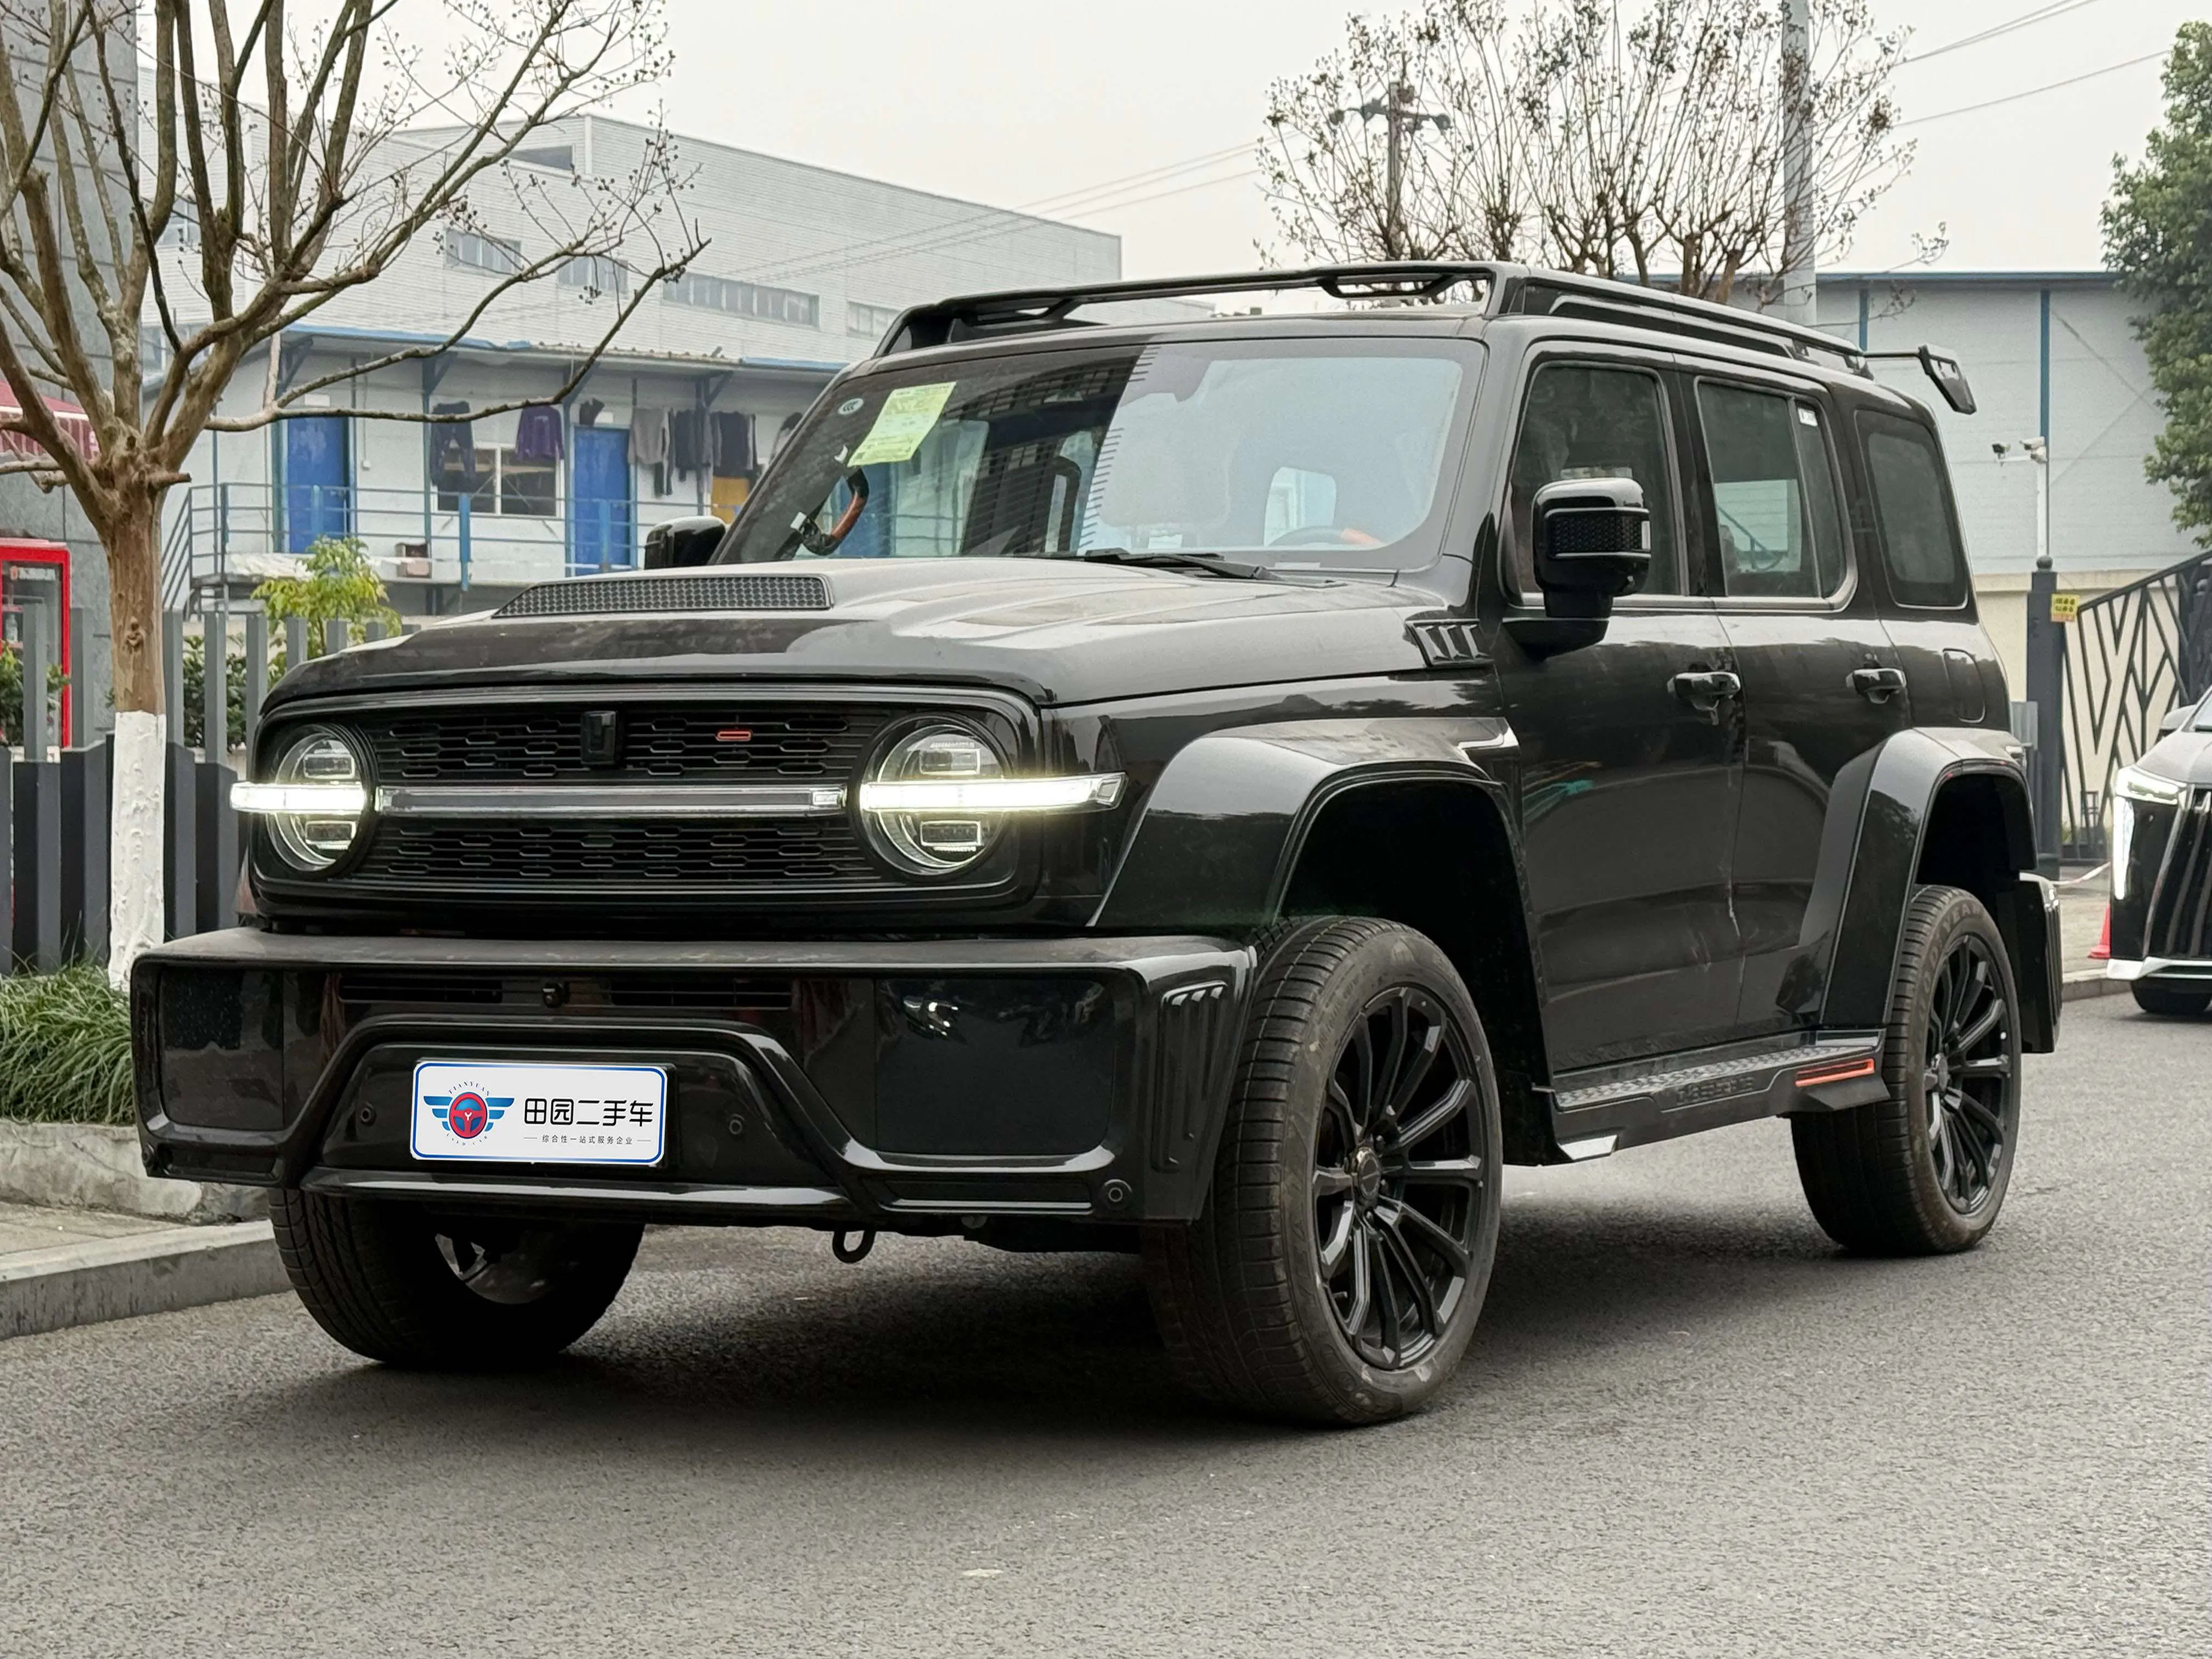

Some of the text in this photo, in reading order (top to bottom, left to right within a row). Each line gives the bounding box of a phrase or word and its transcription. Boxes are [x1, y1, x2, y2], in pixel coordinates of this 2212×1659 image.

[448, 1080, 490, 1096] TIANYUAN
[524, 1098, 653, 1127] 田园二手车
[542, 1134, 633, 1145] 综合性一站式服务企业
